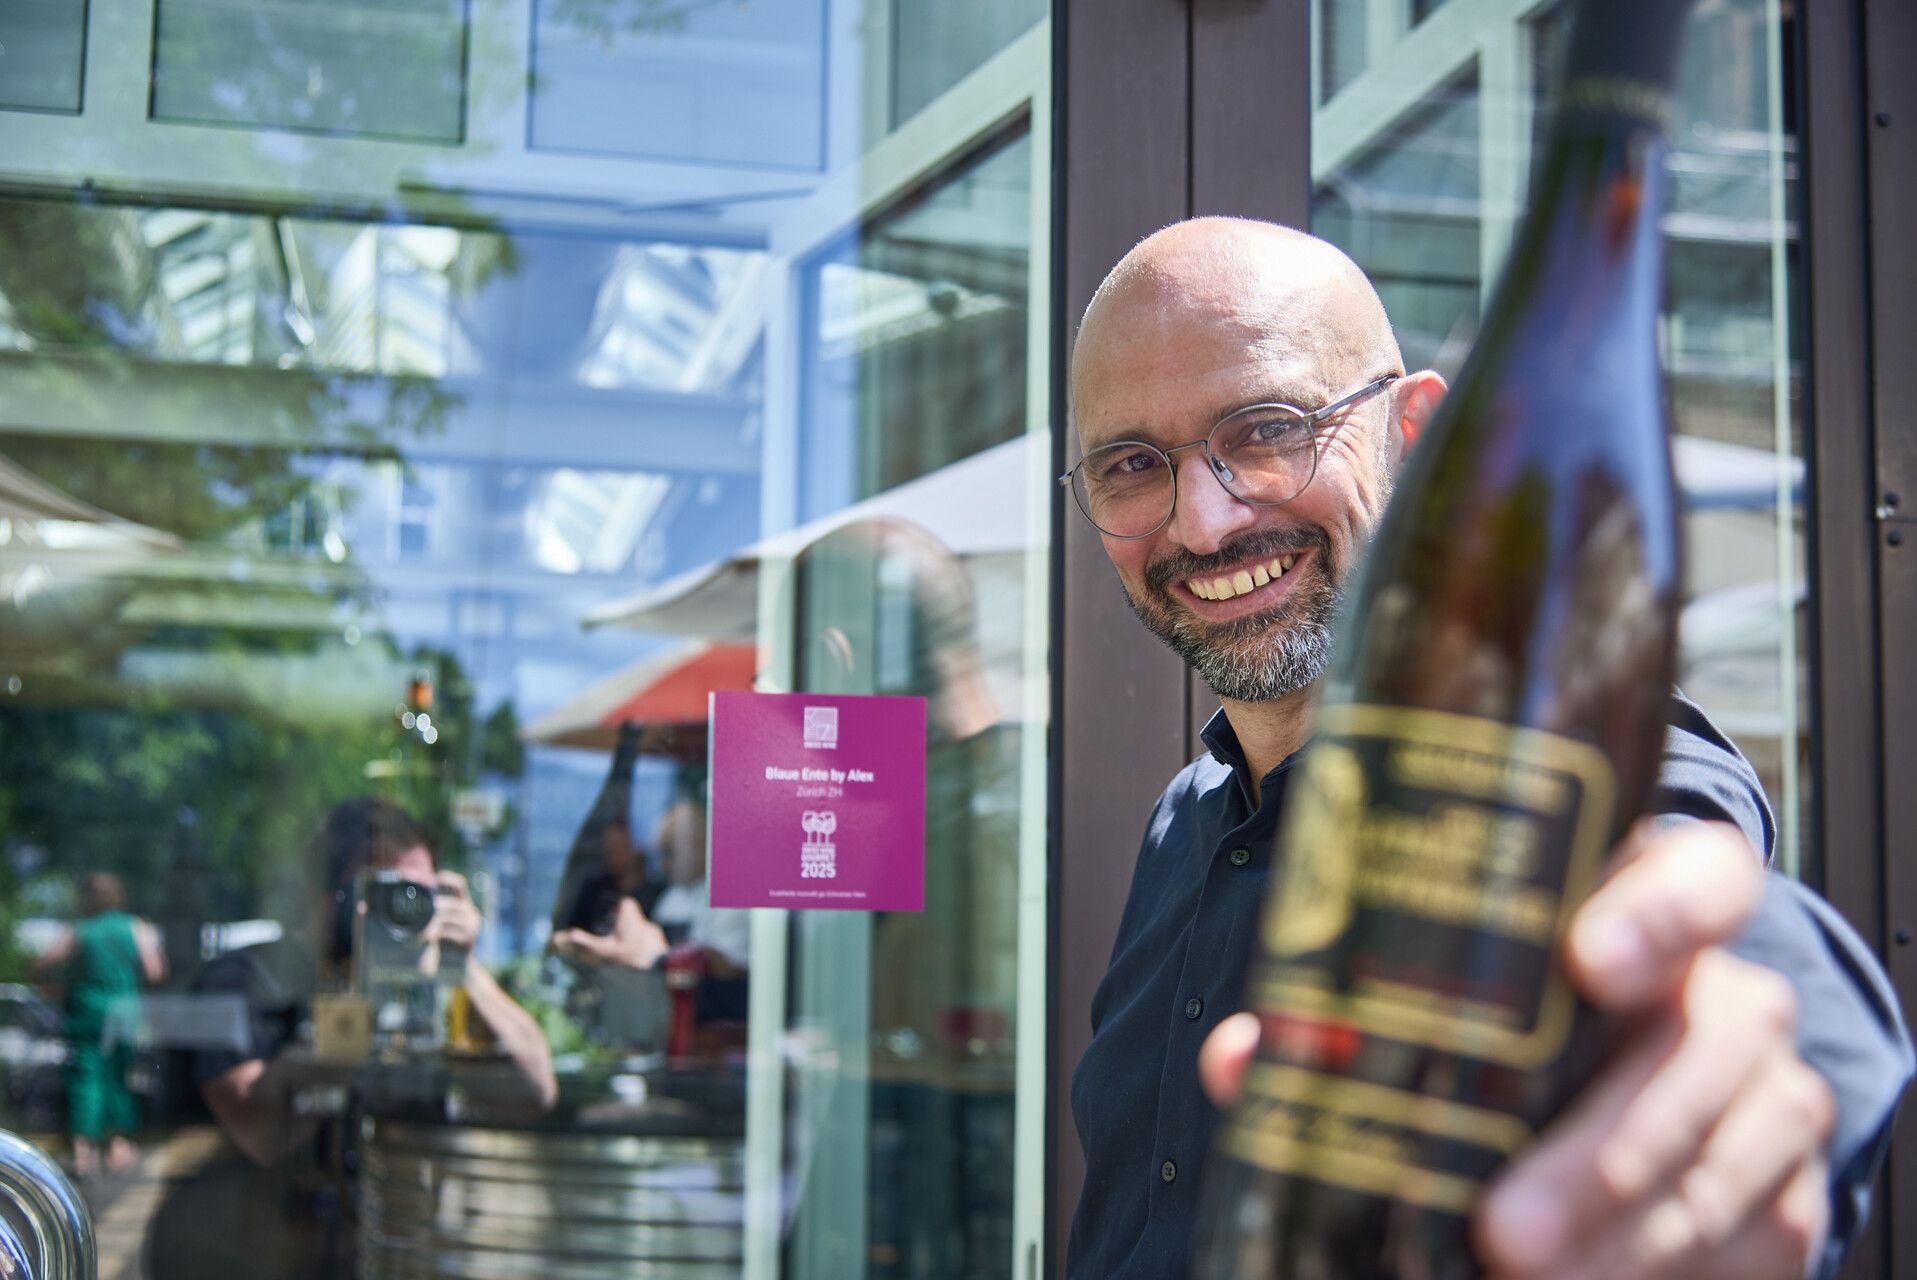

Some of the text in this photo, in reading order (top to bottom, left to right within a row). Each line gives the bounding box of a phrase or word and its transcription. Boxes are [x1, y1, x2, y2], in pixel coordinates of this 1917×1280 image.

[765, 766, 874, 784] Blaue Ente by Alex
[796, 784, 826, 797] Zürich
[801, 862, 837, 879] 2025
